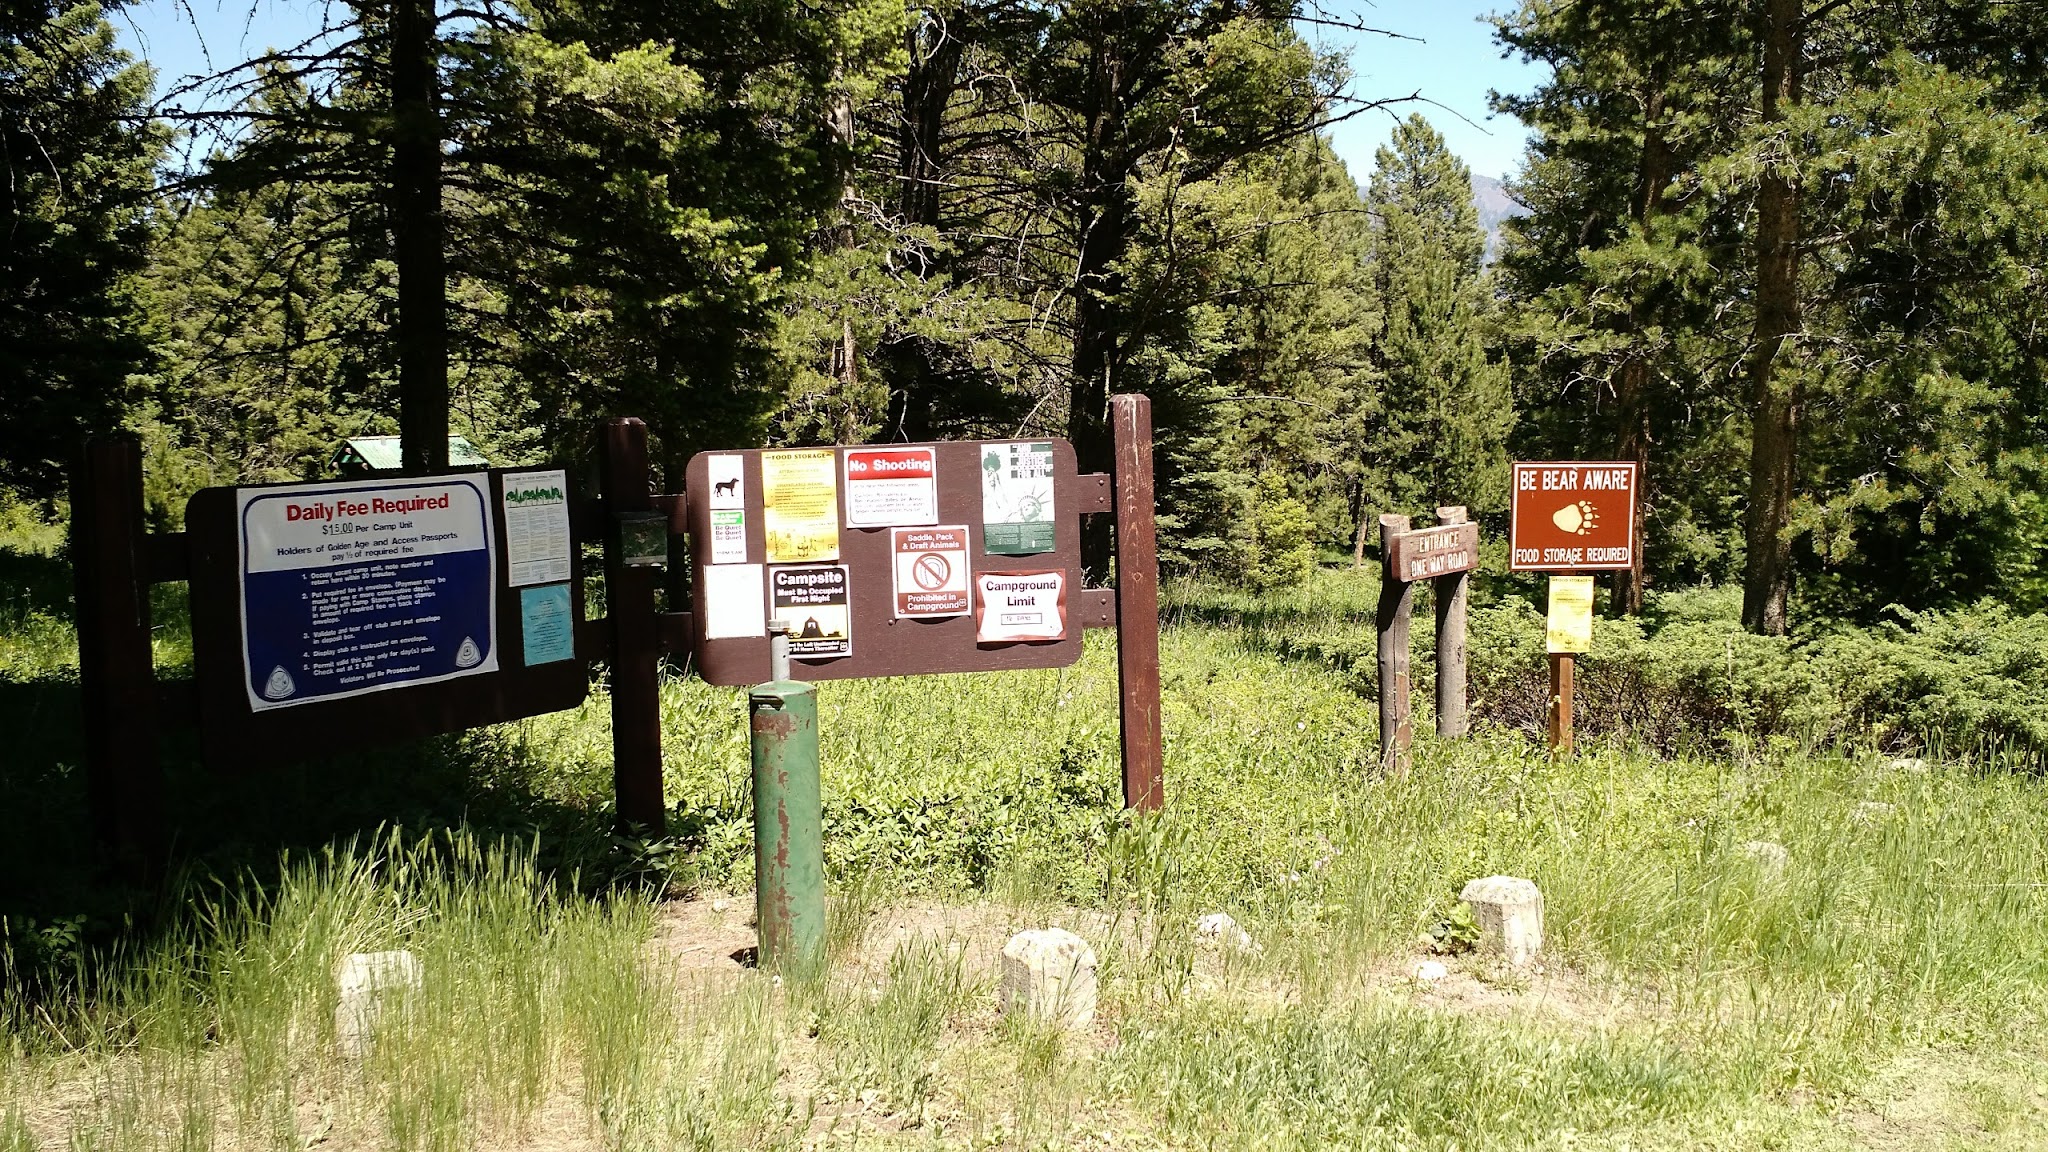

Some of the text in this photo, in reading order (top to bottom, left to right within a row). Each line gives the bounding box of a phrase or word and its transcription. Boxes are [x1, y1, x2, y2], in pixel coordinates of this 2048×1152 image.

[850, 459, 931, 472] No Shooting
[1520, 470, 1629, 490] BE BEAR AWARE
[287, 493, 448, 521] Daily Fee Required
[322, 523, 353, 535] $15.00
[277, 548, 312, 556] Holders
[328, 543, 351, 551] Golden
[355, 541, 369, 549] Age
[422, 533, 457, 541] Passports
[1420, 532, 1459, 552] ENTRANCE
[366, 547, 398, 556] required
[1516, 548, 1628, 562] FOOD STORAGE REQUIRED
[1411, 551, 1468, 577] ONE WAY ROAD
[777, 572, 842, 586] Campsite
[809, 587, 843, 595] Occupied
[987, 580, 1056, 592] Campground
[324, 588, 347, 597] required
[377, 588, 412, 596] consecutive
[810, 595, 830, 603] Night
[1008, 596, 1035, 606] Limit
[350, 604, 374, 613] required
[908, 602, 959, 611] Campground
[361, 640, 389, 649] instructed
[313, 661, 335, 669] Permit
[336, 658, 349, 666] valid
[387, 665, 421, 674] Prosecuted
